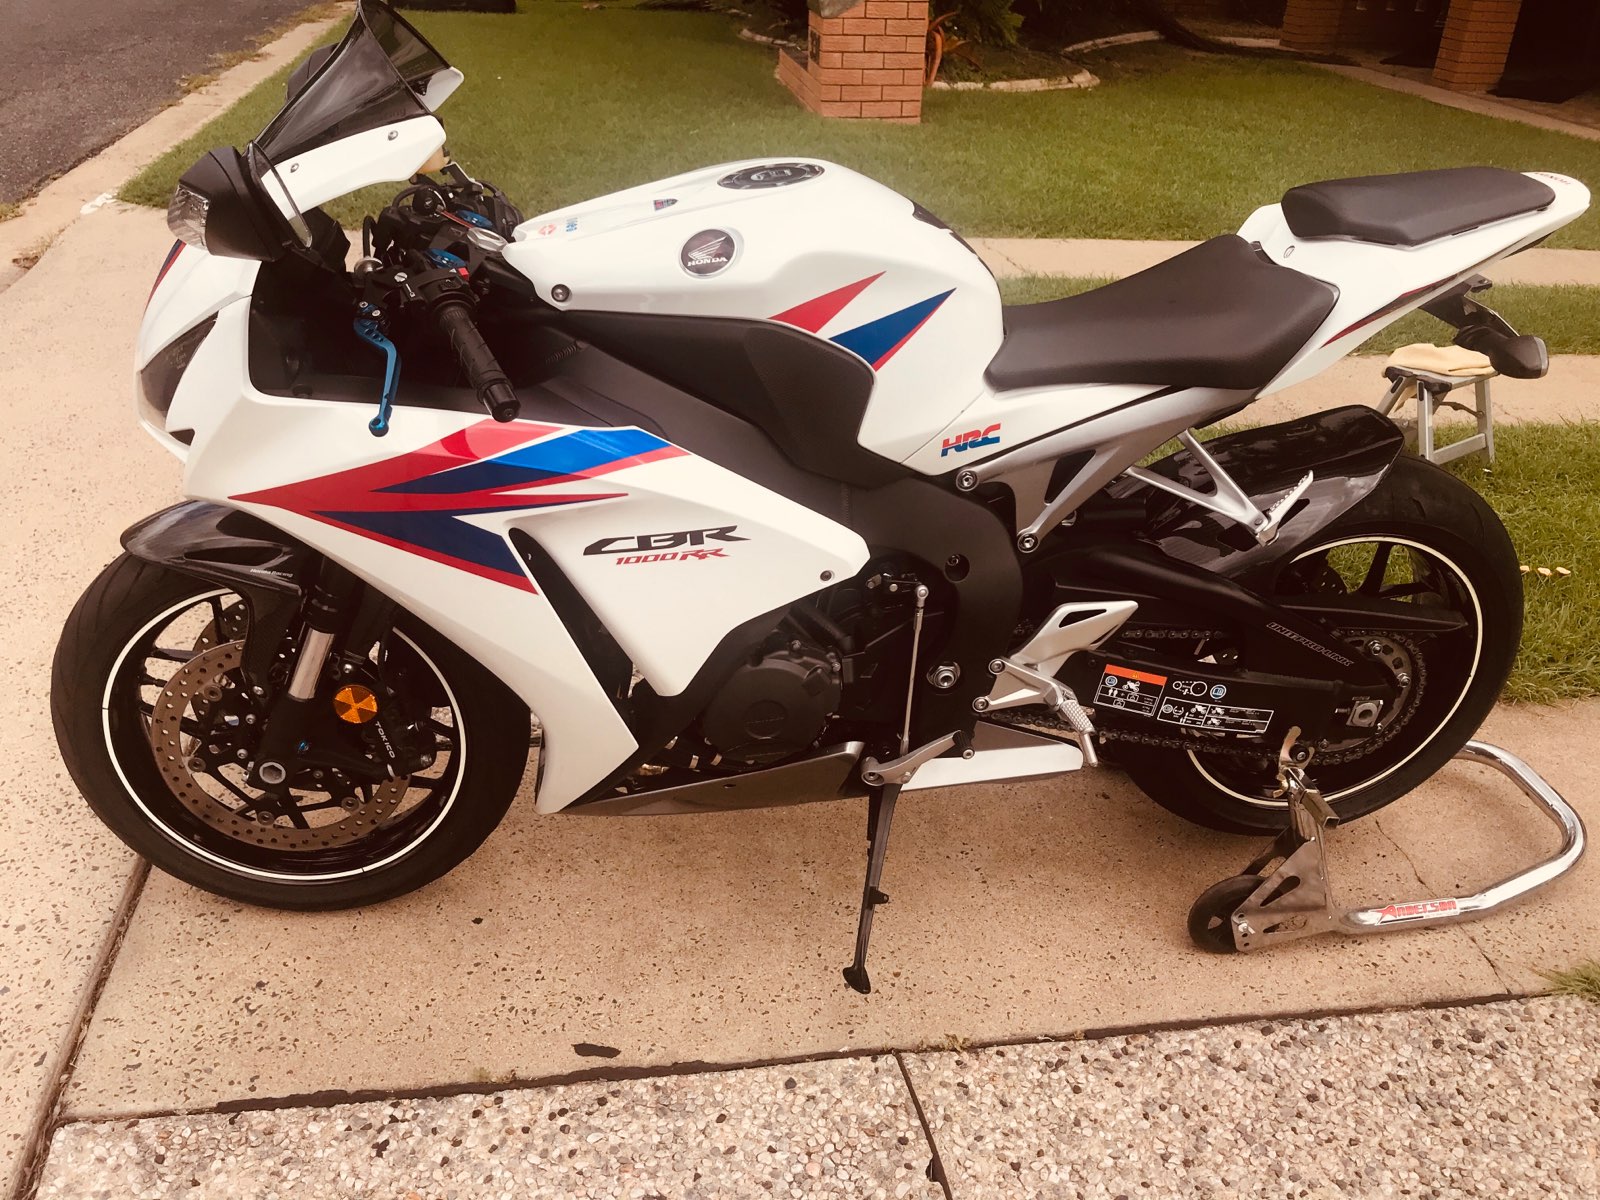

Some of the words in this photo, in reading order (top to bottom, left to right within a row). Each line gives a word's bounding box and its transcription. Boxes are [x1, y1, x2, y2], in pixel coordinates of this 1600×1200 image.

[687, 256, 729, 267] HONDA
[941, 423, 1001, 457] HRC
[583, 525, 751, 556] CBR
[375, 720, 396, 759] TOKICO
